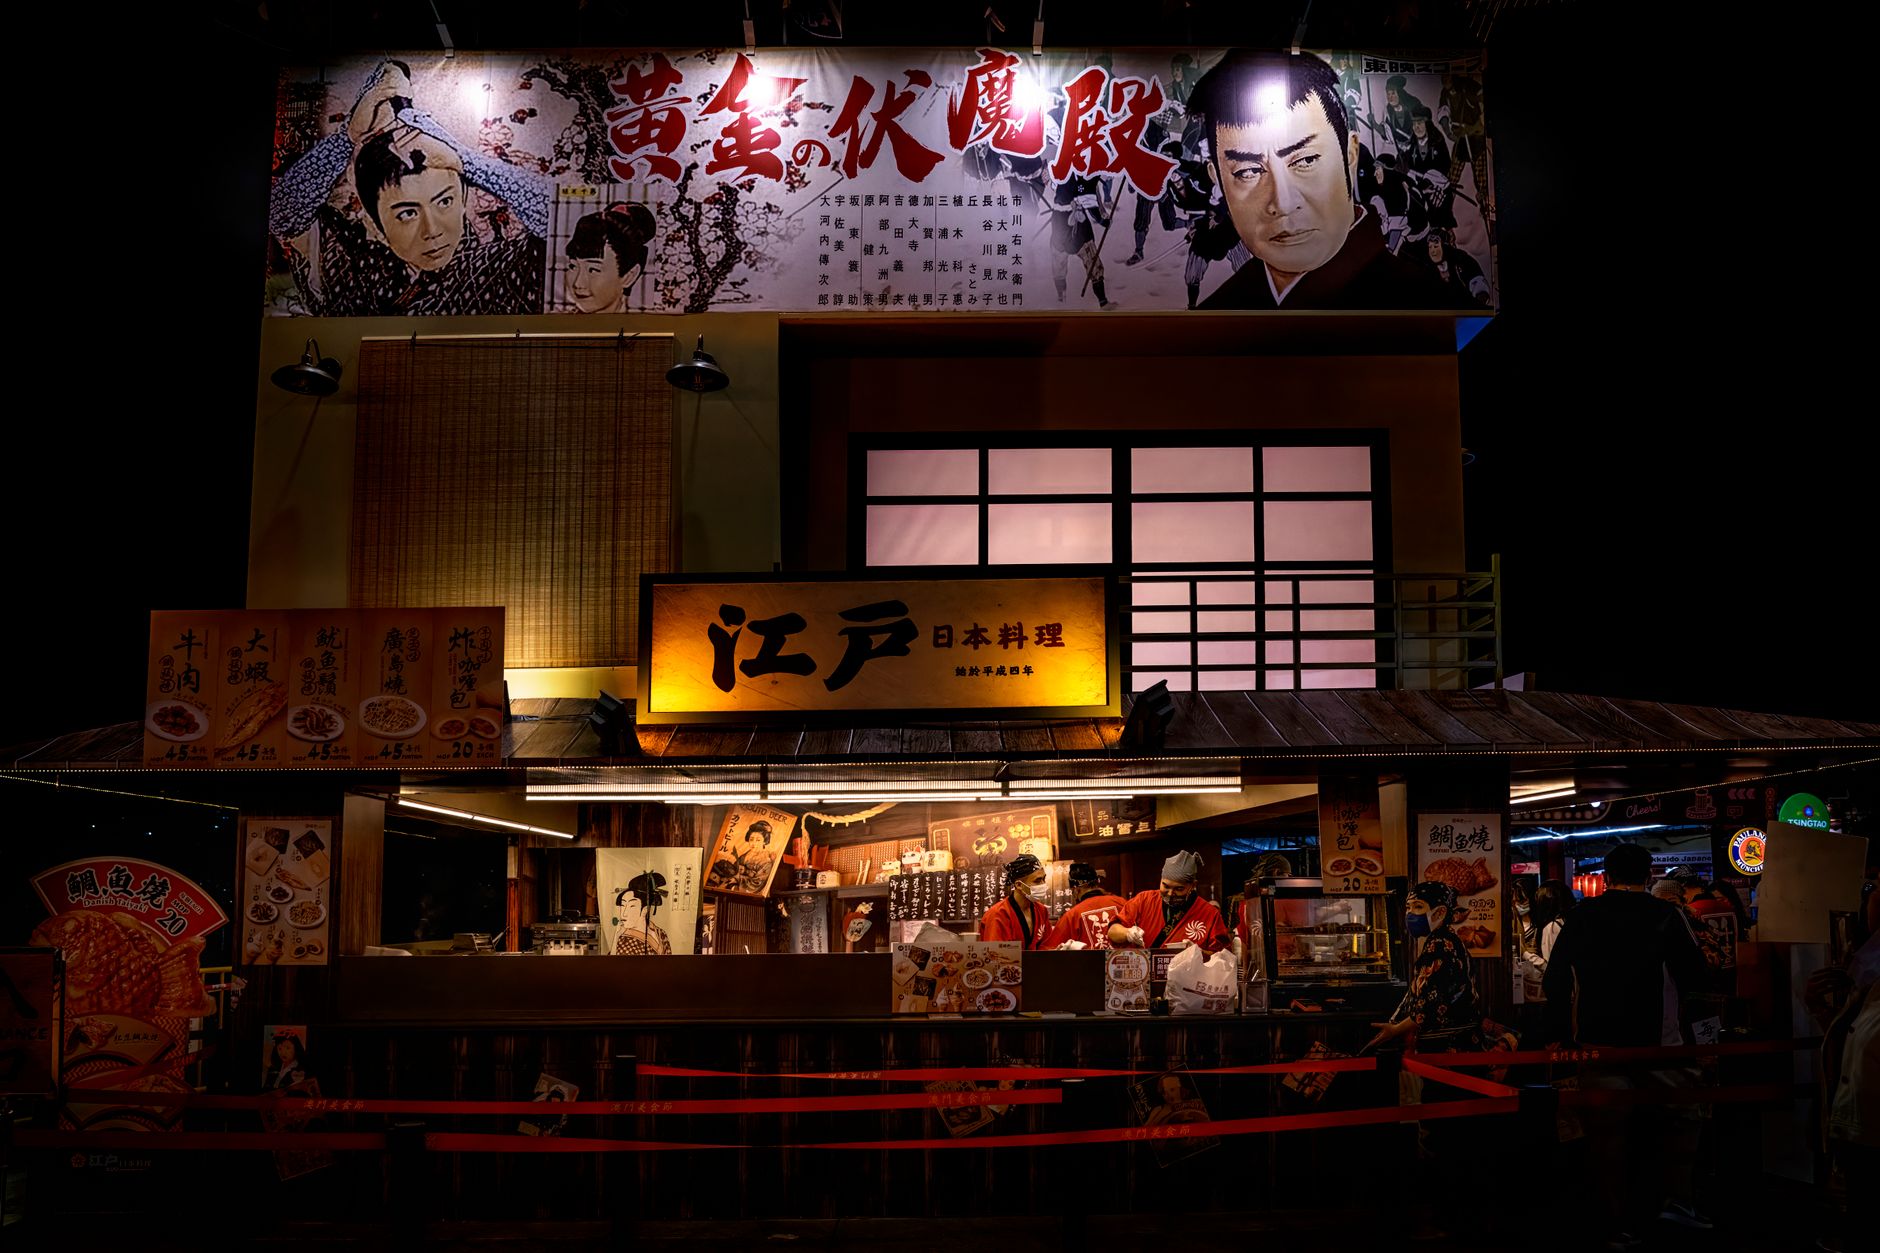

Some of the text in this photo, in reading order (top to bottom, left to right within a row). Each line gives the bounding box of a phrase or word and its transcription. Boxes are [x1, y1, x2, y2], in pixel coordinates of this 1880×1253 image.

[937, 195, 949, 305] 三浦光子
[967, 195, 978, 305] 丘さとみ
[997, 195, 1008, 305] 北大路欣也
[932, 621, 1066, 650] 日本料理
[173, 628, 203, 694] 牛肉
[244, 628, 274, 685] 大蝦
[955, 664, 1034, 677] 始於平成四年
[165, 744, 190, 762] 45
[236, 744, 261, 762] 45
[308, 743, 332, 761] 45
[379, 743, 405, 760] 45
[452, 741, 474, 758] 20
[1787, 818, 1828, 828] TSINGTAO
[1427, 824, 1494, 854] 鯛魚燒
[66, 864, 172, 911] 鯛魚燒
[1343, 877, 1361, 891] 20
[116, 898, 149, 914] Taiyaki
[171, 899, 190, 915] MOP
[156, 907, 189, 937] 20
